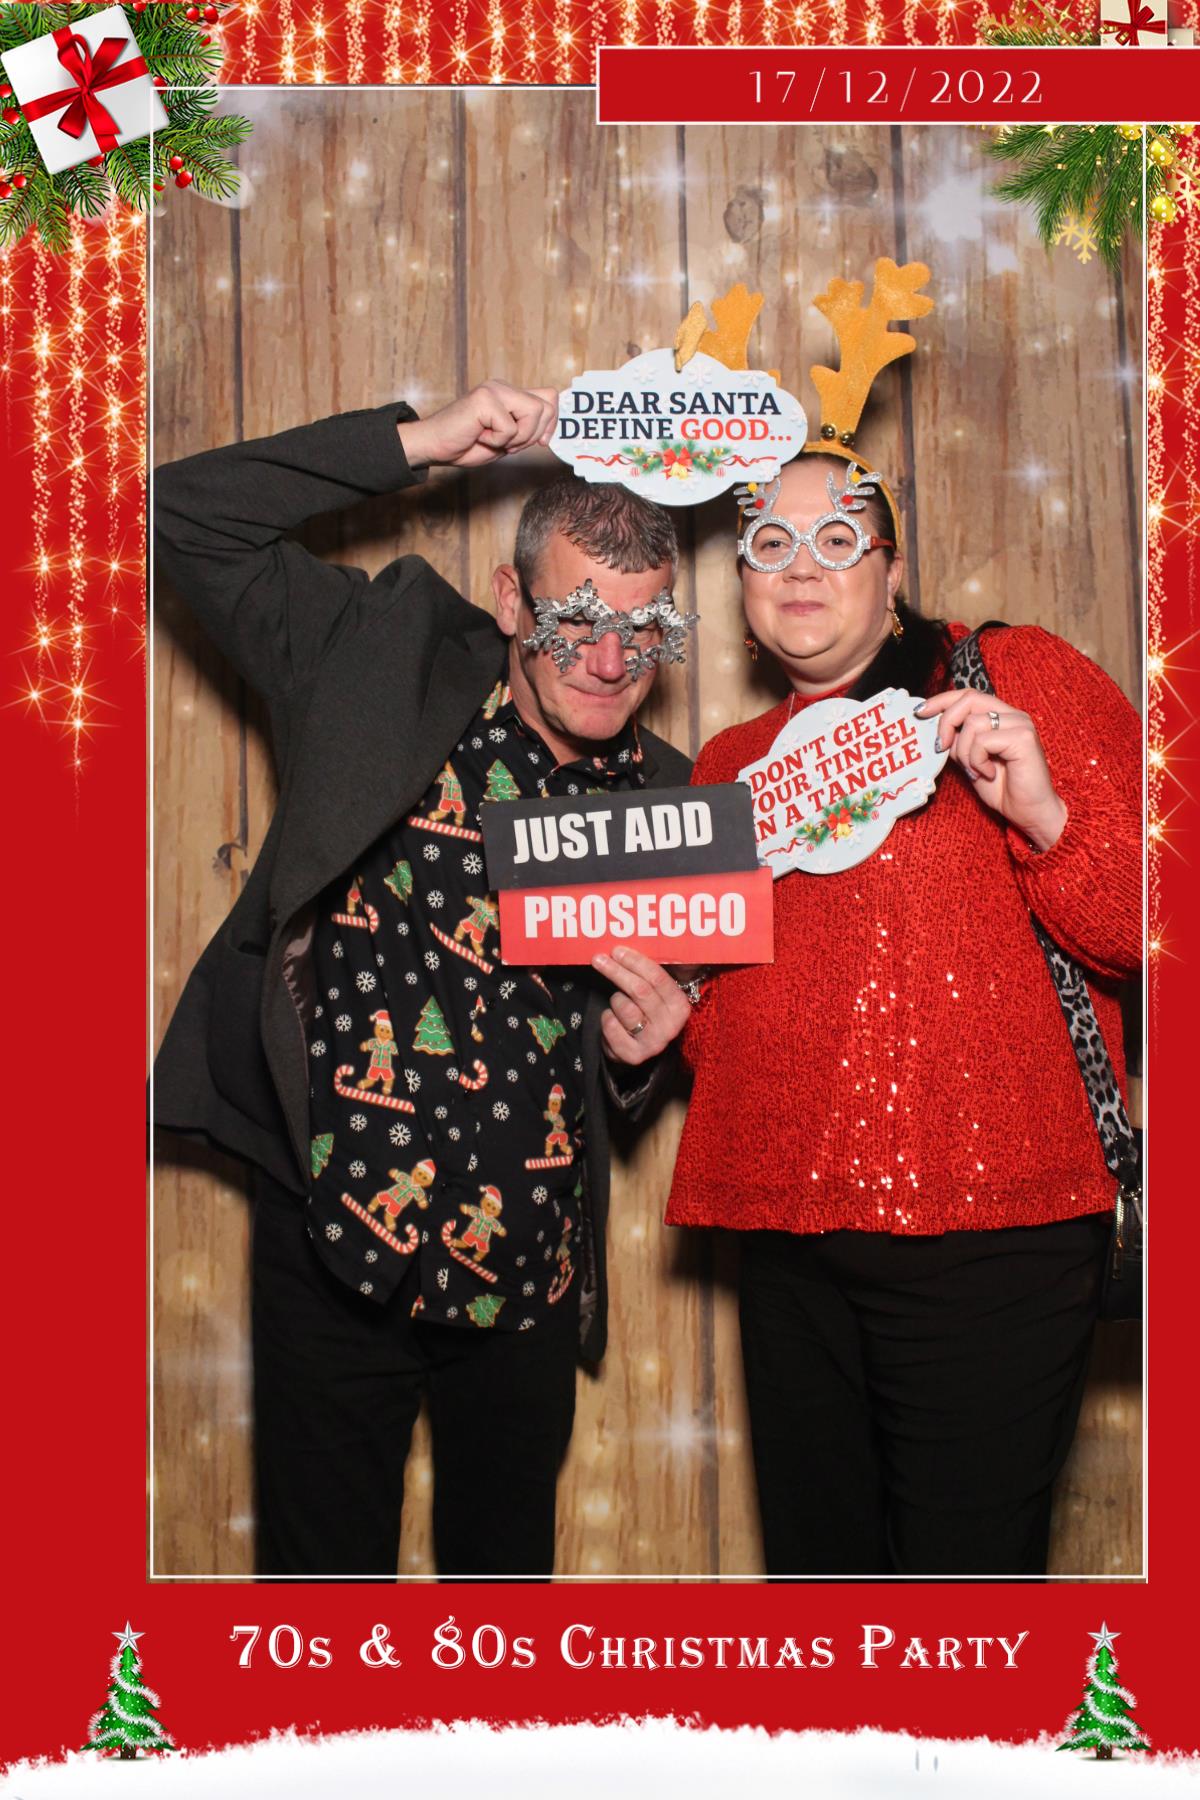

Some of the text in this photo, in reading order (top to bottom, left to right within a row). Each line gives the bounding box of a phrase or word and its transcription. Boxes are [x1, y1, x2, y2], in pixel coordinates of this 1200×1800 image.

[558, 418, 792, 441] DEFINE GOOD...
[571, 391, 782, 415] DEAR SANTA
[749, 702, 886, 794] DON'T GET
[751, 717, 917, 819] OUR TINSEL
[754, 738, 922, 844] N A TANGLE
[513, 801, 713, 865] JUST ADD
[524, 892, 746, 938] PROSECCO
